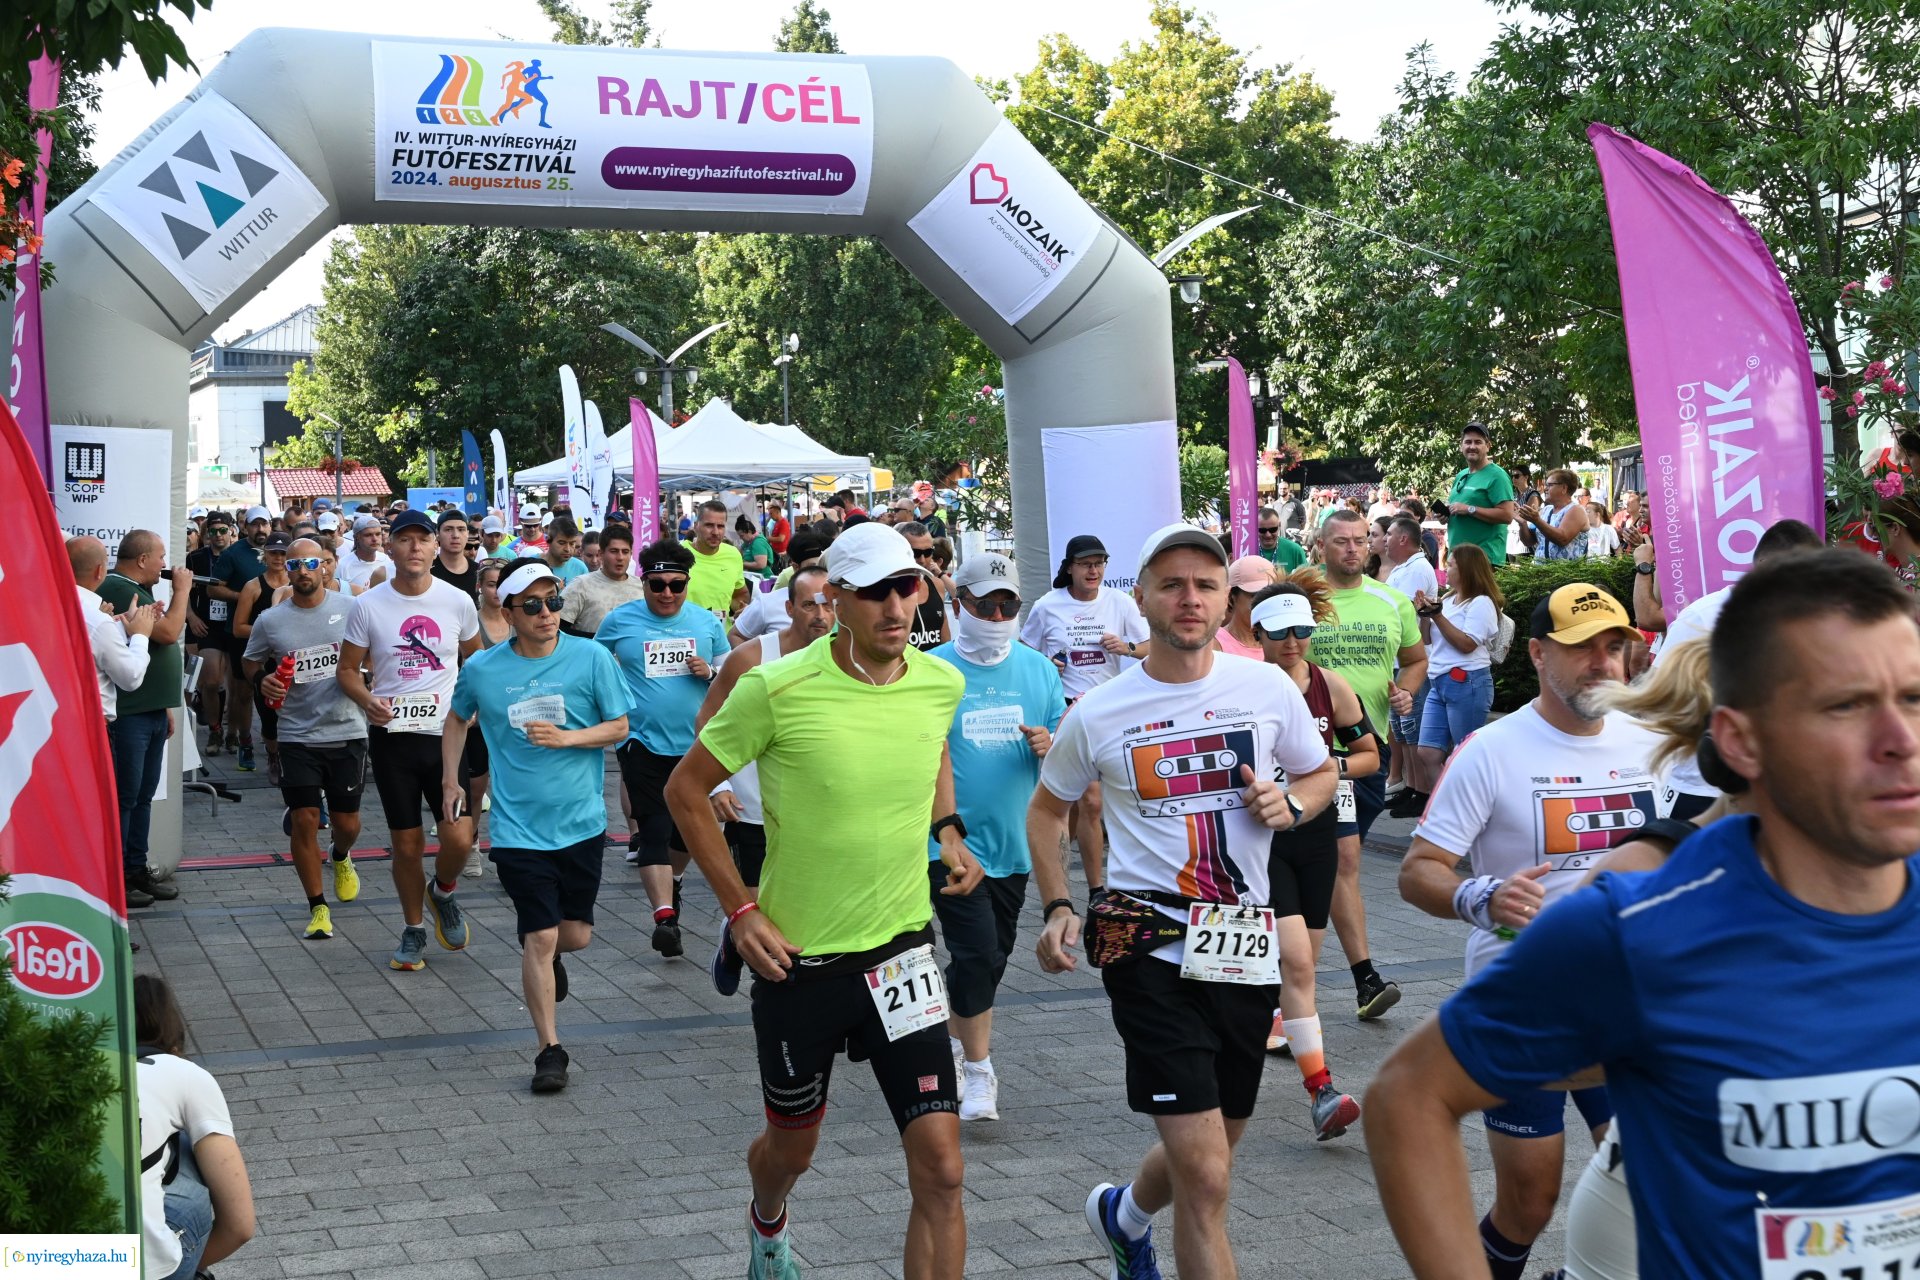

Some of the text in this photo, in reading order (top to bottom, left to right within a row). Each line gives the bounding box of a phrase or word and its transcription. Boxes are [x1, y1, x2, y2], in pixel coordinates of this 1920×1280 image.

[597, 76, 860, 124] RAJT/CÉL
[394, 132, 577, 151] IV. WITTUR-NYÍREGYHÁZI
[391, 146, 576, 174] FUTÓFESZTIVÁL
[391, 170, 574, 190] 2024. augusztus 25.
[614, 164, 843, 182] www.nyiregyhazifutofesztival.hu
[218, 206, 279, 262] WITTUR
[1001, 196, 1069, 264] MOZAIK
[988, 216, 1051, 278] Az orvosi futóközösség
[1038, 251, 1060, 271] med
[65, 483, 105, 493] SCOPE
[72, 494, 98, 504] WHP
[1352, 622, 1363, 631] 40
[1365, 624, 1376, 632] en
[1378, 624, 1387, 634] ga
[909, 630, 940, 644] OLICE
[1311, 633, 1387, 645] mezelf verwennen
[1313, 646, 1333, 656] door
[1335, 645, 1346, 654] de
[296, 654, 338, 672] 21208
[1321, 658, 1329, 667] te
[392, 705, 437, 719] 21052
[1273, 766, 1285, 782] 2
[1158, 928, 1180, 936] Kodak
[1193, 930, 1269, 958] 21129
[1489, 1117, 1539, 1134] LURBEL
